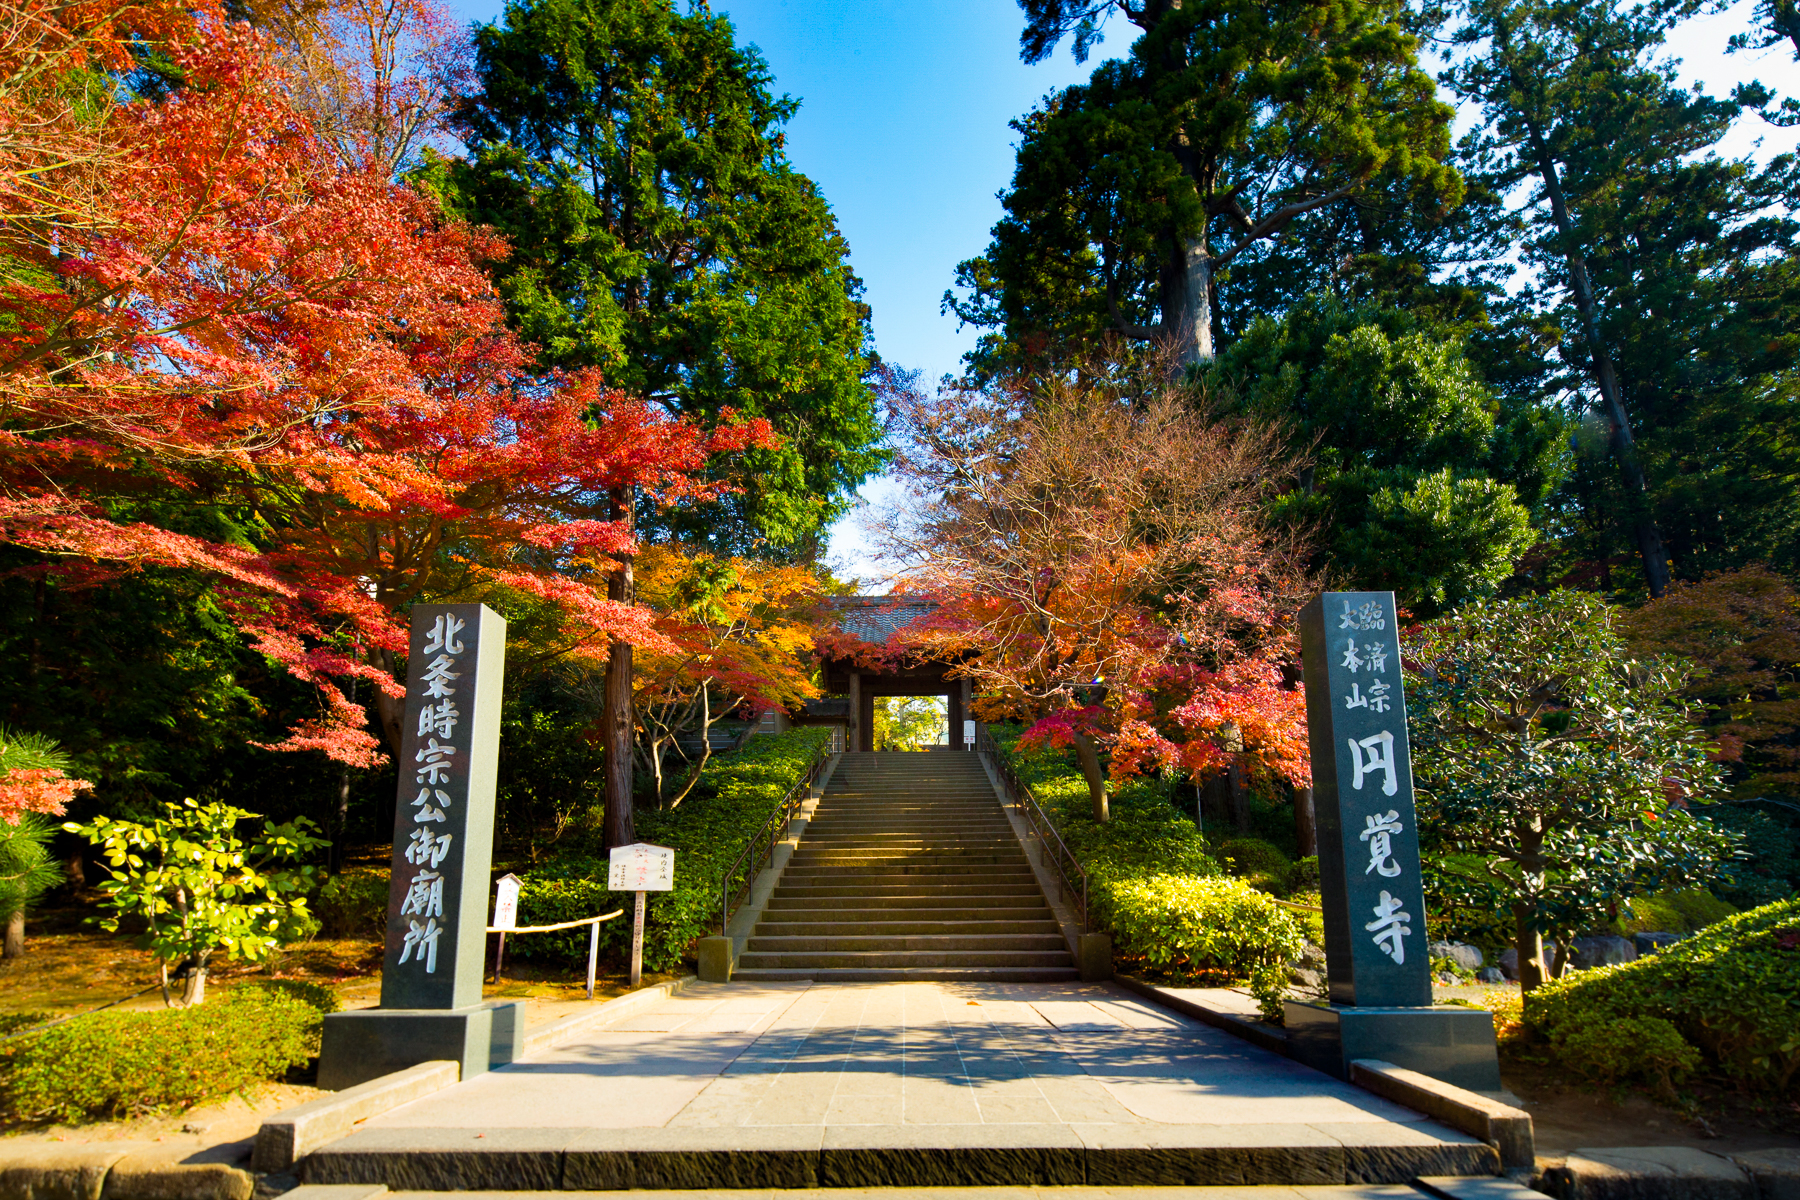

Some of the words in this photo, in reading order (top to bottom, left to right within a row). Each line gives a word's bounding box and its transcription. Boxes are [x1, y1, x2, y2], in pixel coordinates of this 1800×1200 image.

[1338, 600, 1368, 710] 大本山
[1359, 600, 1390, 713] 臨済宗
[398, 612, 466, 973] 北条時宗公御廟所
[1347, 730, 1412, 965] 円覚寺
